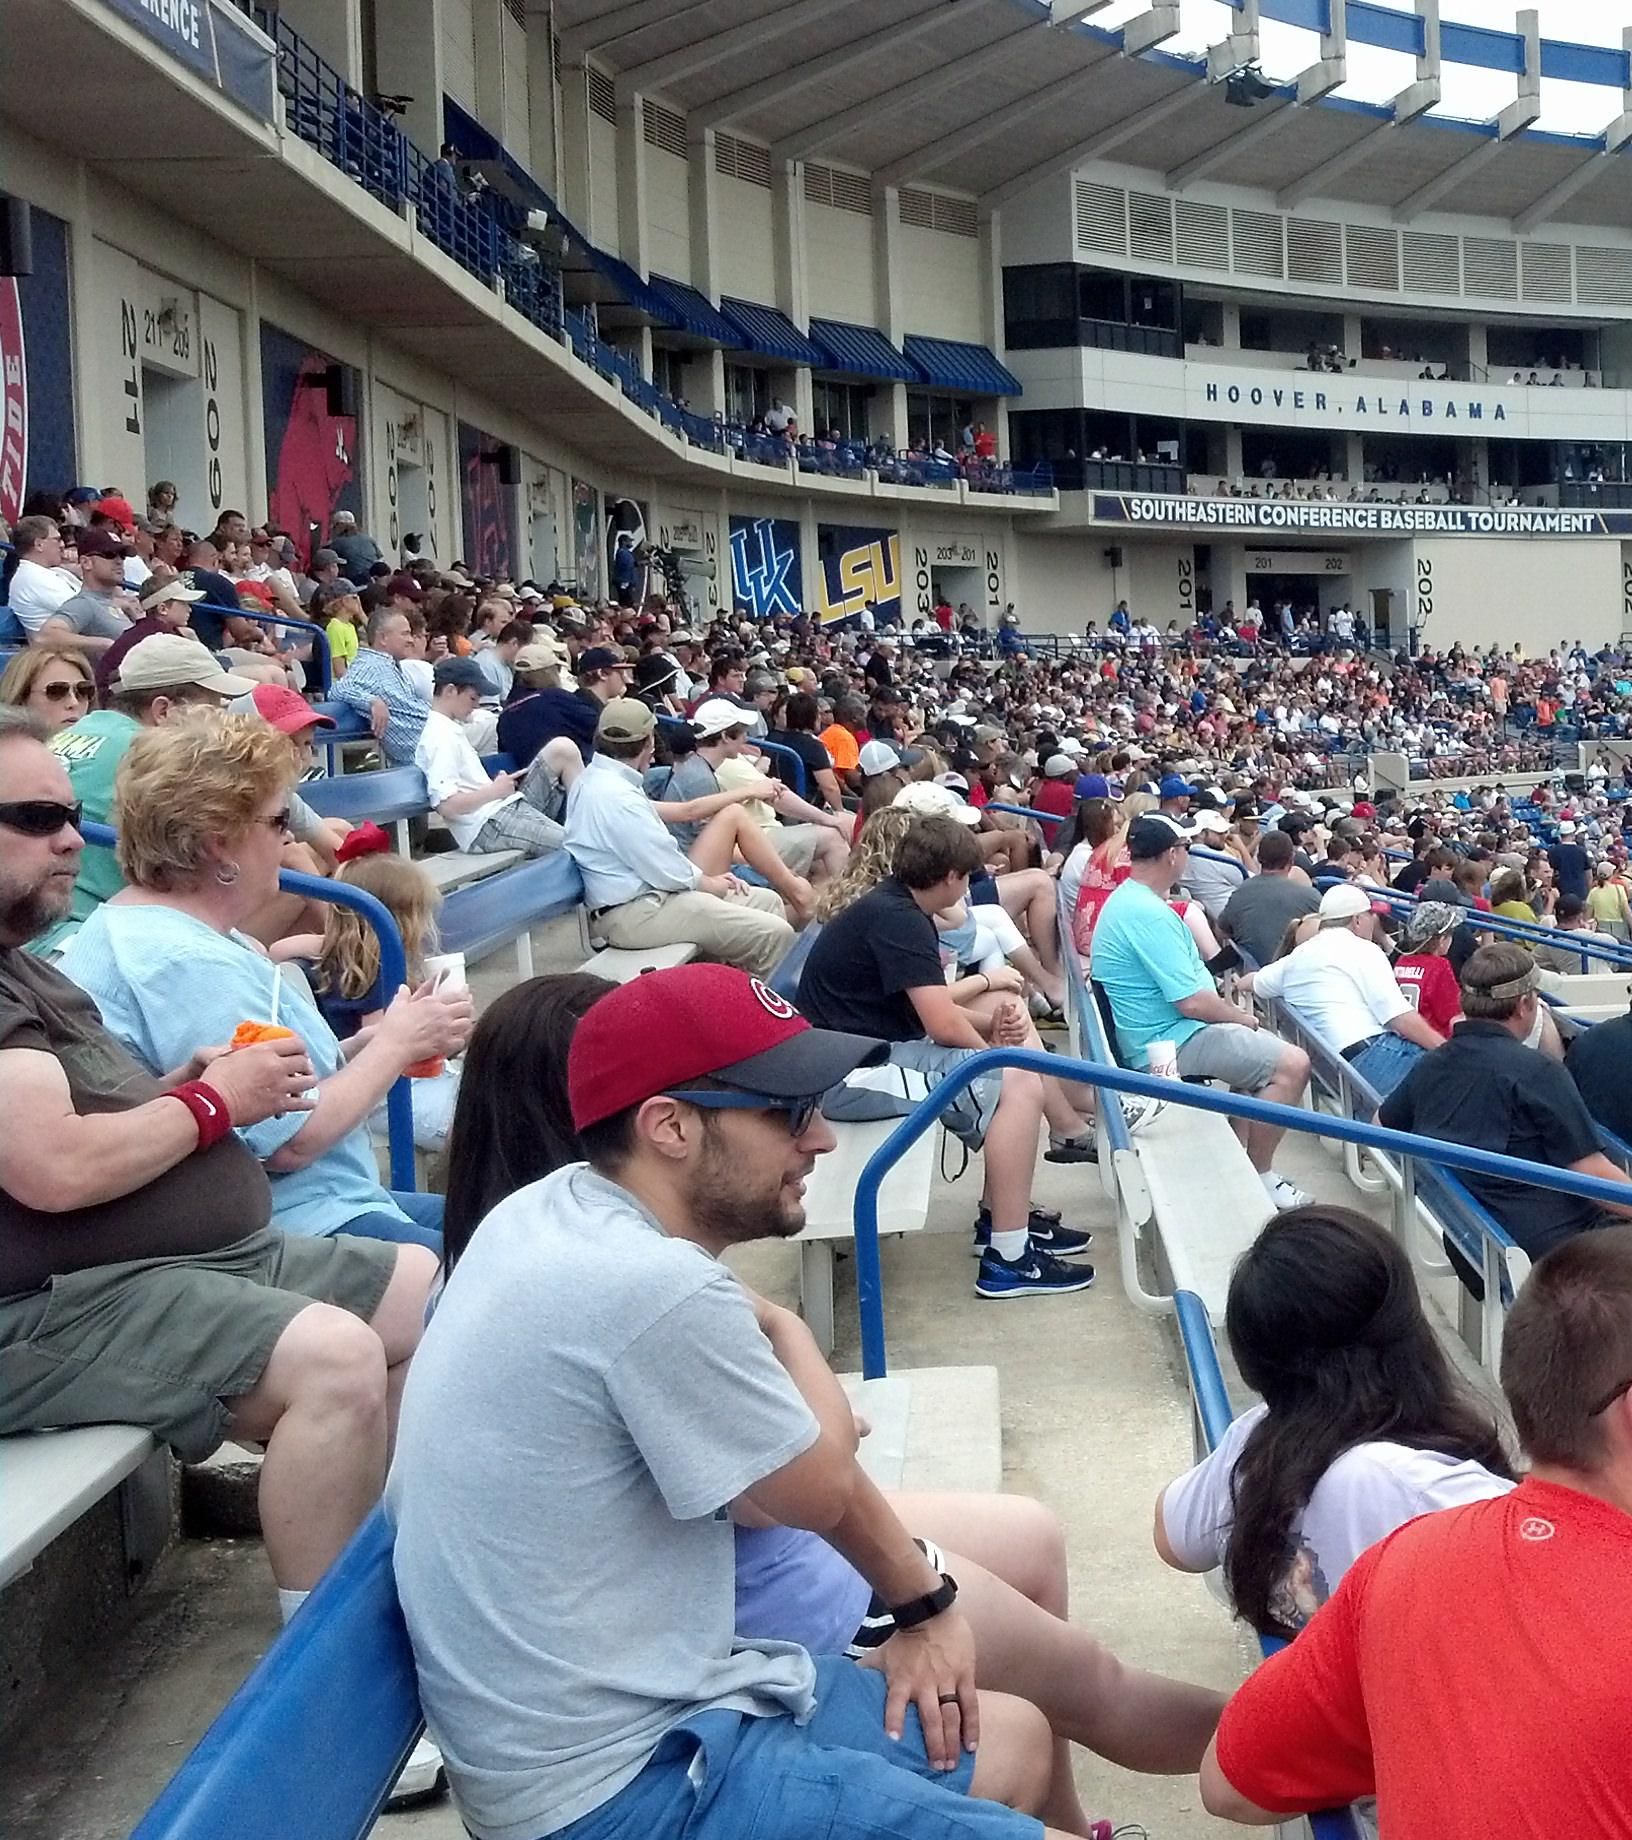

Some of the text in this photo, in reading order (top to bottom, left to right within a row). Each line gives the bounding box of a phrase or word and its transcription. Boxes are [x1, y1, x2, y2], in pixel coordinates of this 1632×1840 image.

[204, 336, 222, 509] 209
[1206, 383, 1506, 421] HOOVER, ALABAMA
[1130, 498, 1595, 533] SOUTHEASTERN CONFERENCE BASEBALL TOURNAMENT
[818, 534, 900, 625] LSU
[915, 547, 930, 613] 203
[937, 547, 976, 561] 203 201
[986, 551, 1000, 607] 201
[1255, 557, 1343, 571] 201 202
[1178, 559, 1192, 609] 201
[1417, 558, 1433, 615] 202
